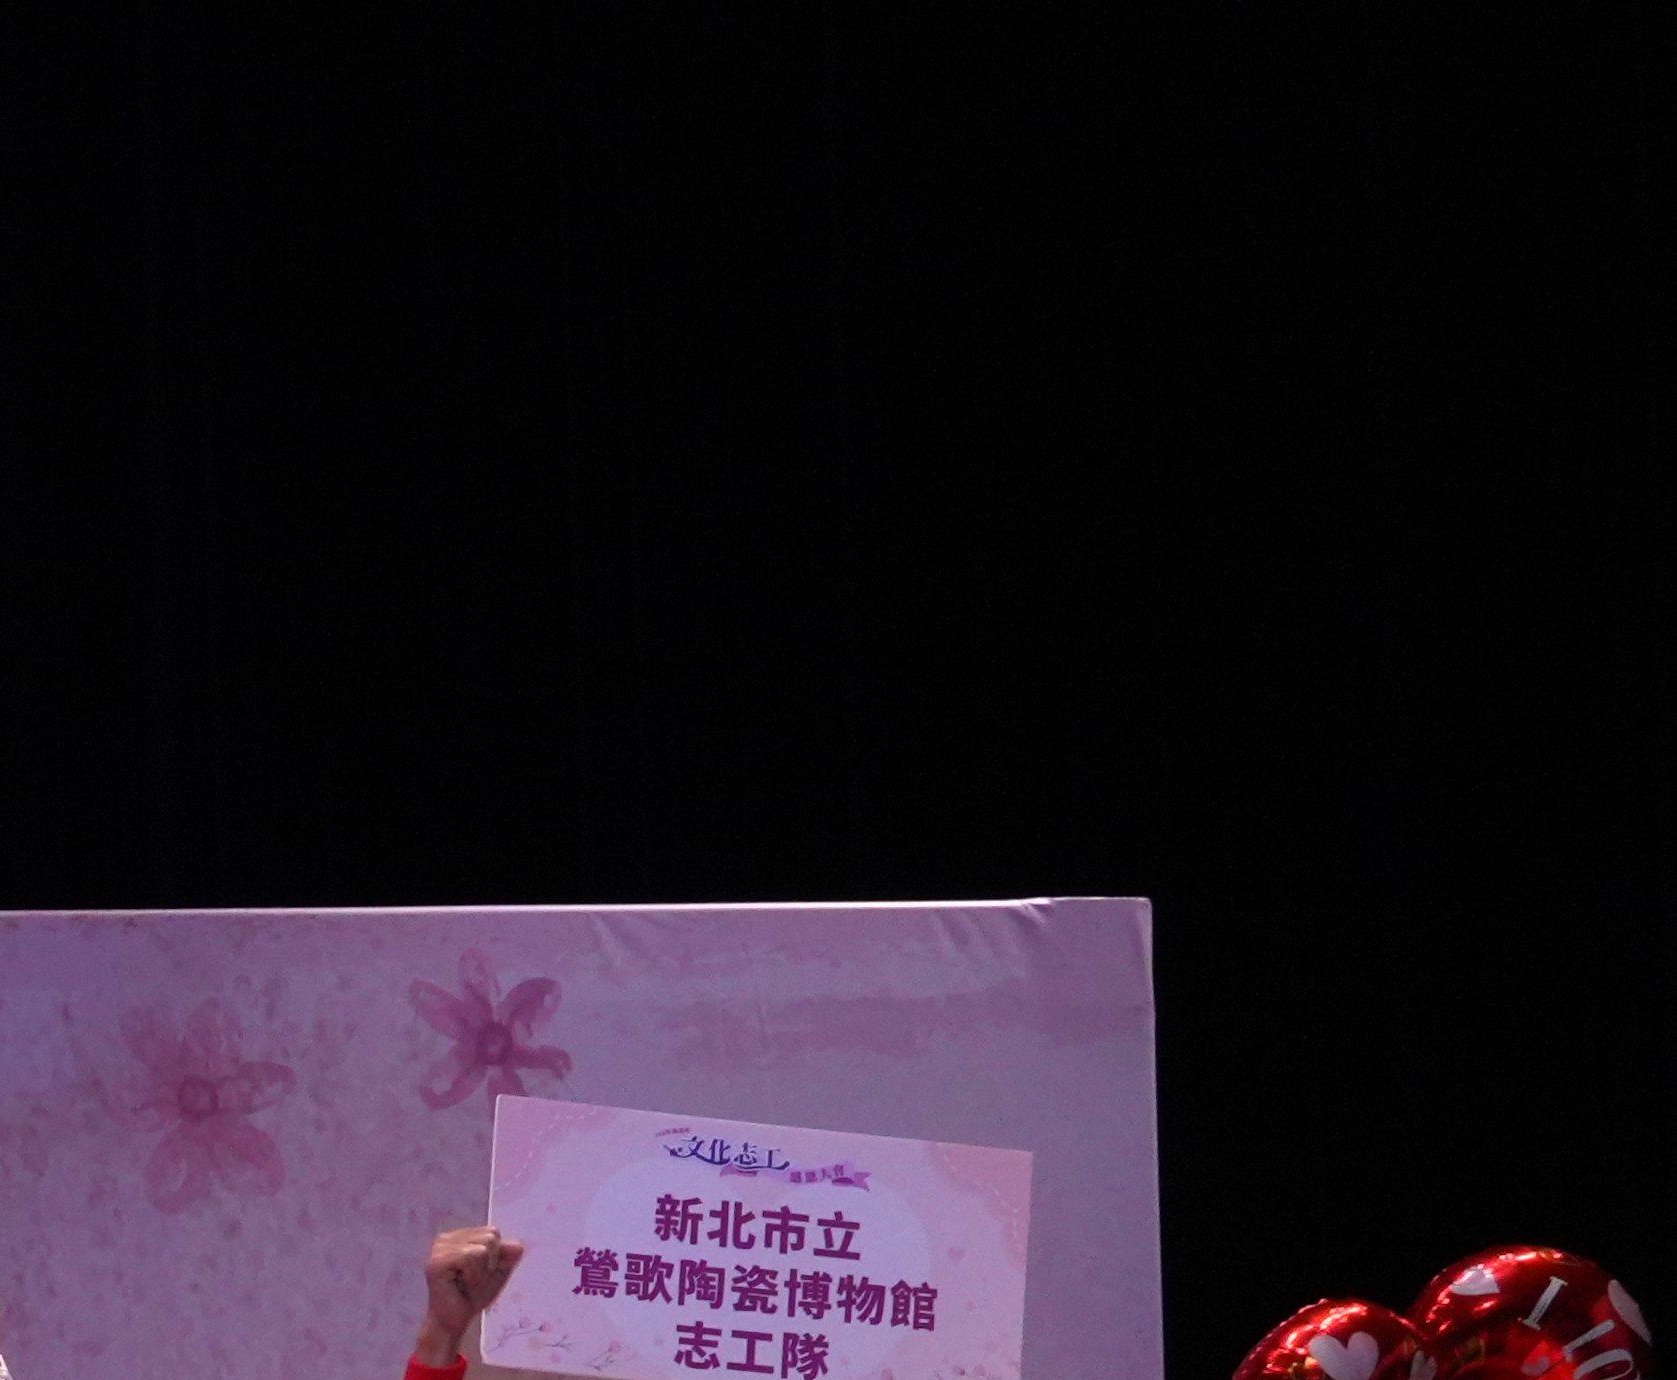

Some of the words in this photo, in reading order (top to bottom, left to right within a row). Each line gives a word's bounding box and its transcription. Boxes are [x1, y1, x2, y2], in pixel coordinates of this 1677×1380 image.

[655, 1194, 862, 1261] 新北市立
[572, 1246, 939, 1332] 鶯歌陶瓷博物館
[1517, 1275, 1569, 1331] I
[674, 1320, 830, 1380] 志工隊
